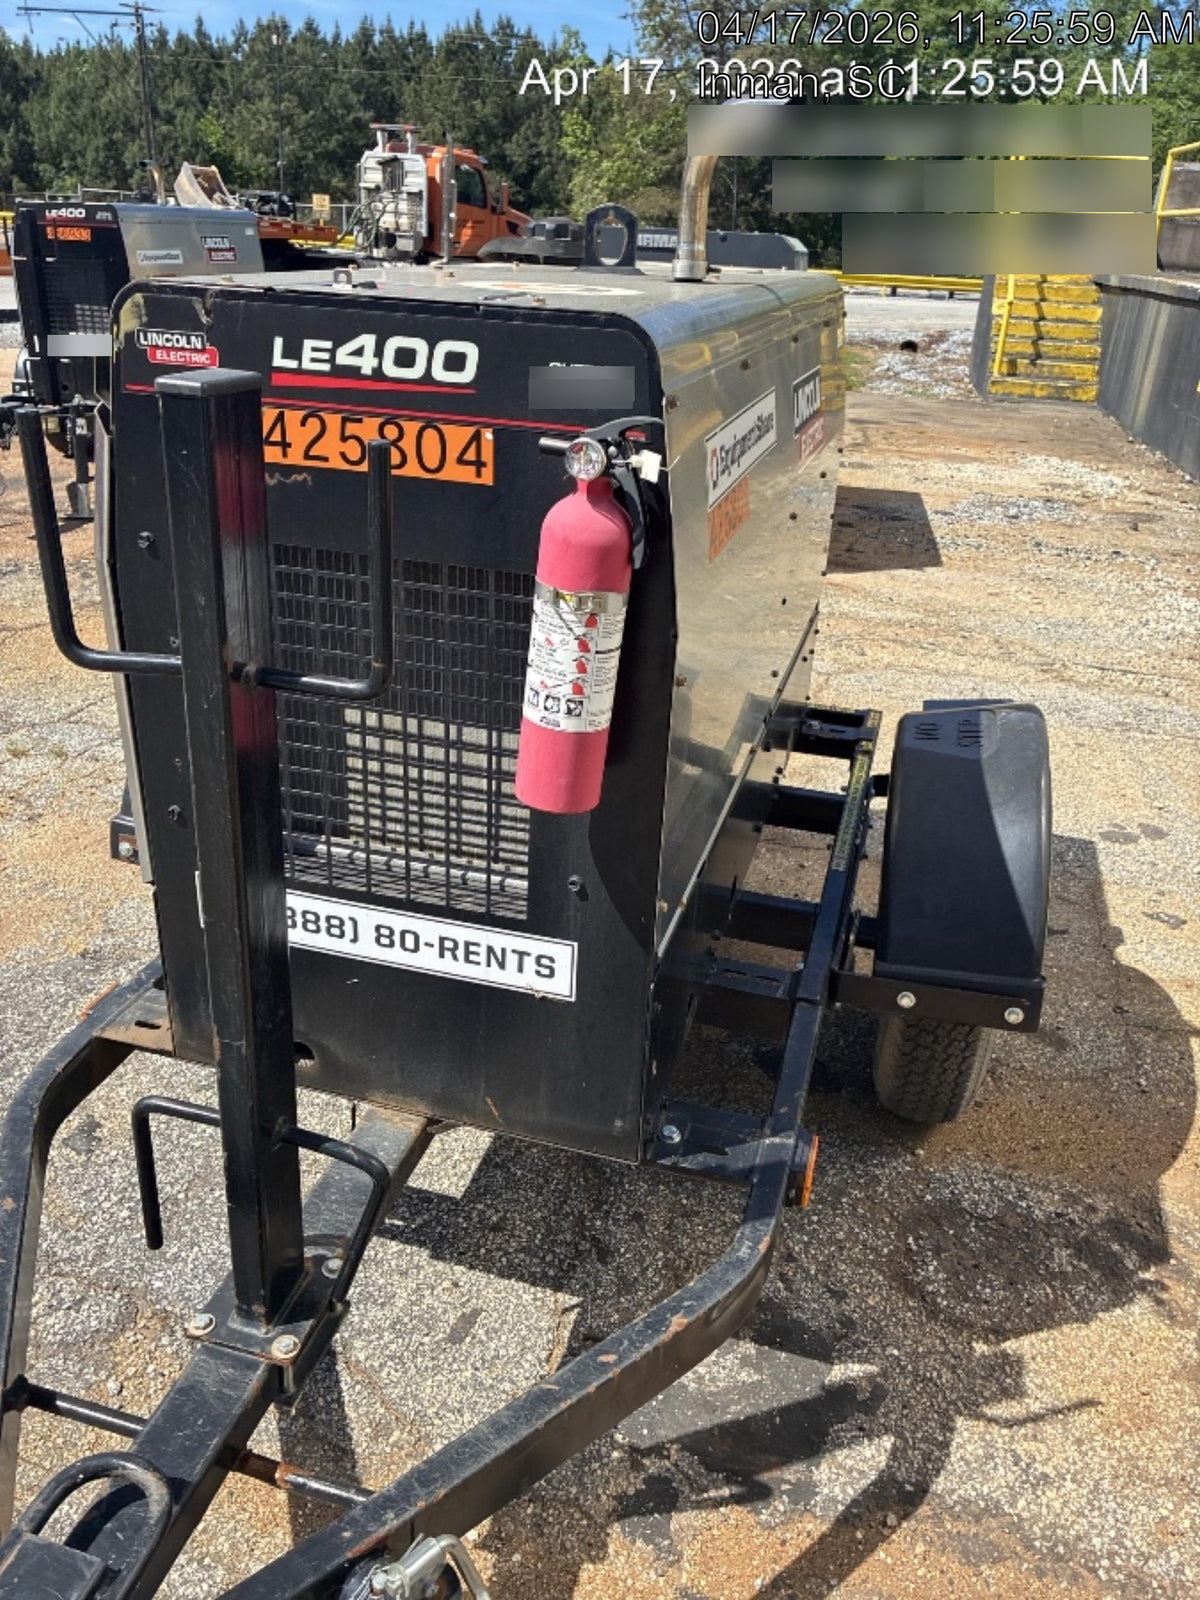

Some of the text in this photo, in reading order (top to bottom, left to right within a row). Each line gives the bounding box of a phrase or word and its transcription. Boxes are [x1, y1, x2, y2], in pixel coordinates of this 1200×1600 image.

[138, 331, 203, 350] LINCOLN
[155, 350, 211, 364] ELECTRIC
[271, 333, 480, 384] LE400
[263, 410, 488, 478] 425804
[374, 923, 557, 980] 80-RENTS
